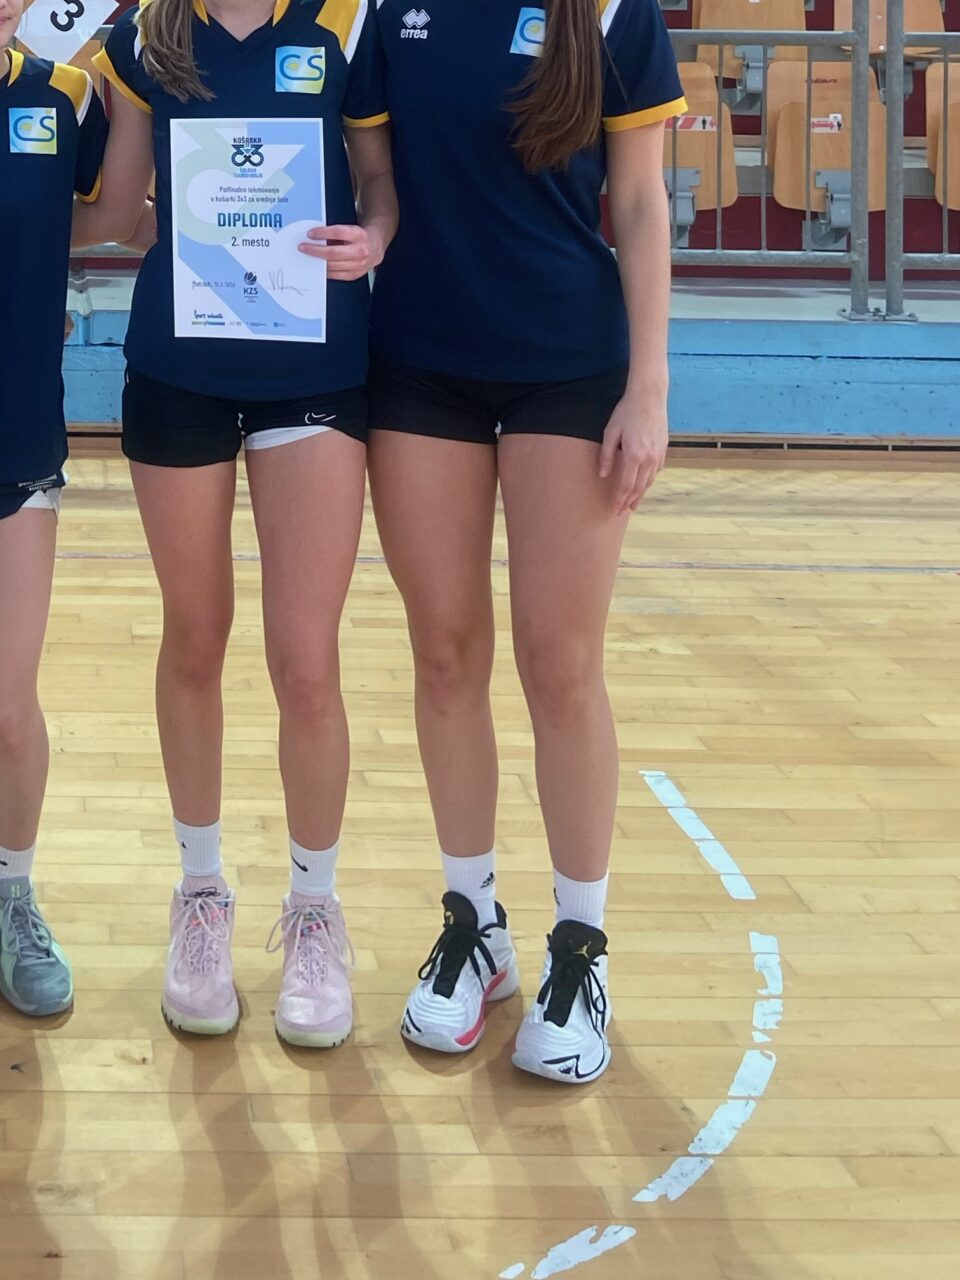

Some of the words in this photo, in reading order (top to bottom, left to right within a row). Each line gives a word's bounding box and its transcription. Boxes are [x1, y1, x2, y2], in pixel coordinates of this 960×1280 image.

[218, 213, 282, 228] DIPLOMA
[232, 236, 239, 246] 2.
[242, 238, 270, 247] mesto
